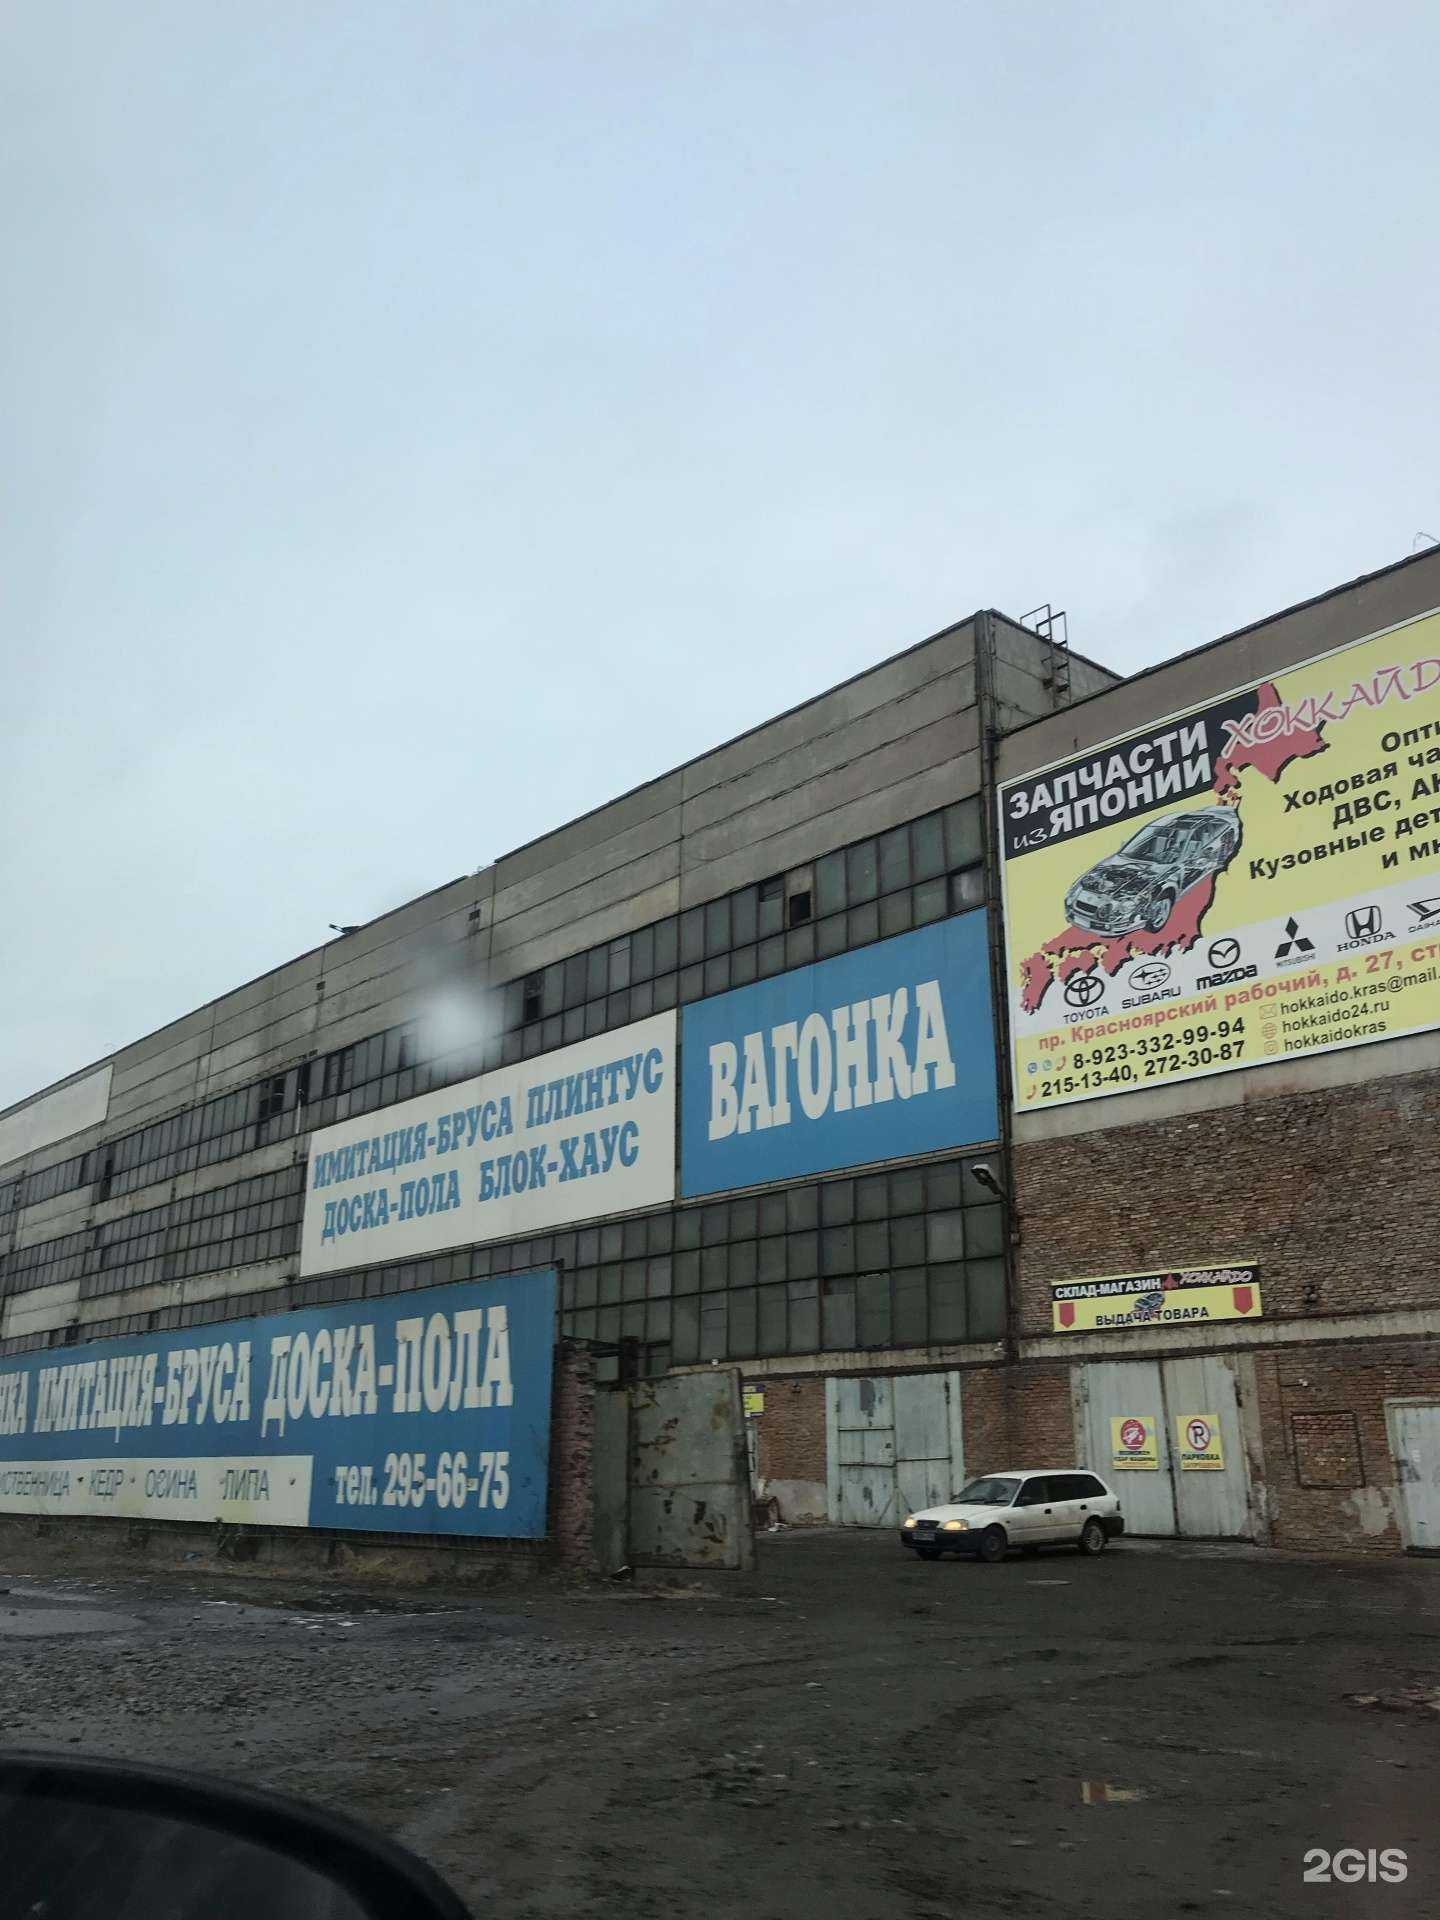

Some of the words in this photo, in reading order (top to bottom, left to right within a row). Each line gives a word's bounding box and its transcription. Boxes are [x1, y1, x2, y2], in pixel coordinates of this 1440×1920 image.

[1381, 720, 1440, 752] Опт
[1009, 720, 1209, 820] ЗАПЧАСТИ
[1282, 761, 1398, 814] Ходовая
[1013, 827, 1049, 850] из
[1050, 752, 1212, 838] ЯПОНИИ
[1332, 789, 1400, 830] ДВС,
[1249, 825, 1385, 880] Кузовные
[1381, 851, 1399, 869] и
[1337, 930, 1396, 953] HONDA
[1039, 1034, 1067, 1053] пр.
[1071, 995, 1218, 1045] Красноярский
[1224, 969, 1329, 1012] рабочий,
[1336, 965, 1358, 984] д.
[1365, 950, 1403, 974] 27,
[1410, 943, 1440, 962] ст
[1063, 1005, 1110, 1025] TOYOTA
[1121, 985, 1182, 1010] SUBARU
[1281, 999, 1391, 1034] hokkaido24.ru
[708, 979, 957, 1142] ВАГОНКА
[1072, 1016, 1246, 1071] 8-923-332-99-94
[1283, 1019, 1388, 1052] hokkaidokras
[1041, 1064, 1139, 1099] 215-13-40,
[1144, 1040, 1246, 1078] 272-30-87
[313, 1095, 514, 1190] ИМИТАЦИЯ-БРУСА
[526, 1047, 664, 1129] ПЛИНТУС
[320, 1168, 462, 1246] ДОСКА-ПОЛА
[478, 1119, 640, 1203] БЛОК-ХАУС
[1055, 1277, 1162, 1300] СКЛАД-МАГАЗИН
[1095, 1309, 1150, 1327] ВЫДАЧА
[1154, 1305, 1210, 1322] ТОВАРА
[33, 1340, 252, 1444] ИМИТАЦИЯ-БРУСА
[261, 1305, 514, 1438] ДОСКА-ПОЛА
[88, 1468, 125, 1501] КЕДР
[145, 1469, 199, 1501] ОСИНА
[222, 1469, 270, 1501] ЛИПА
[335, 1465, 378, 1506] тел.
[383, 1450, 510, 1510] 295-66-75
